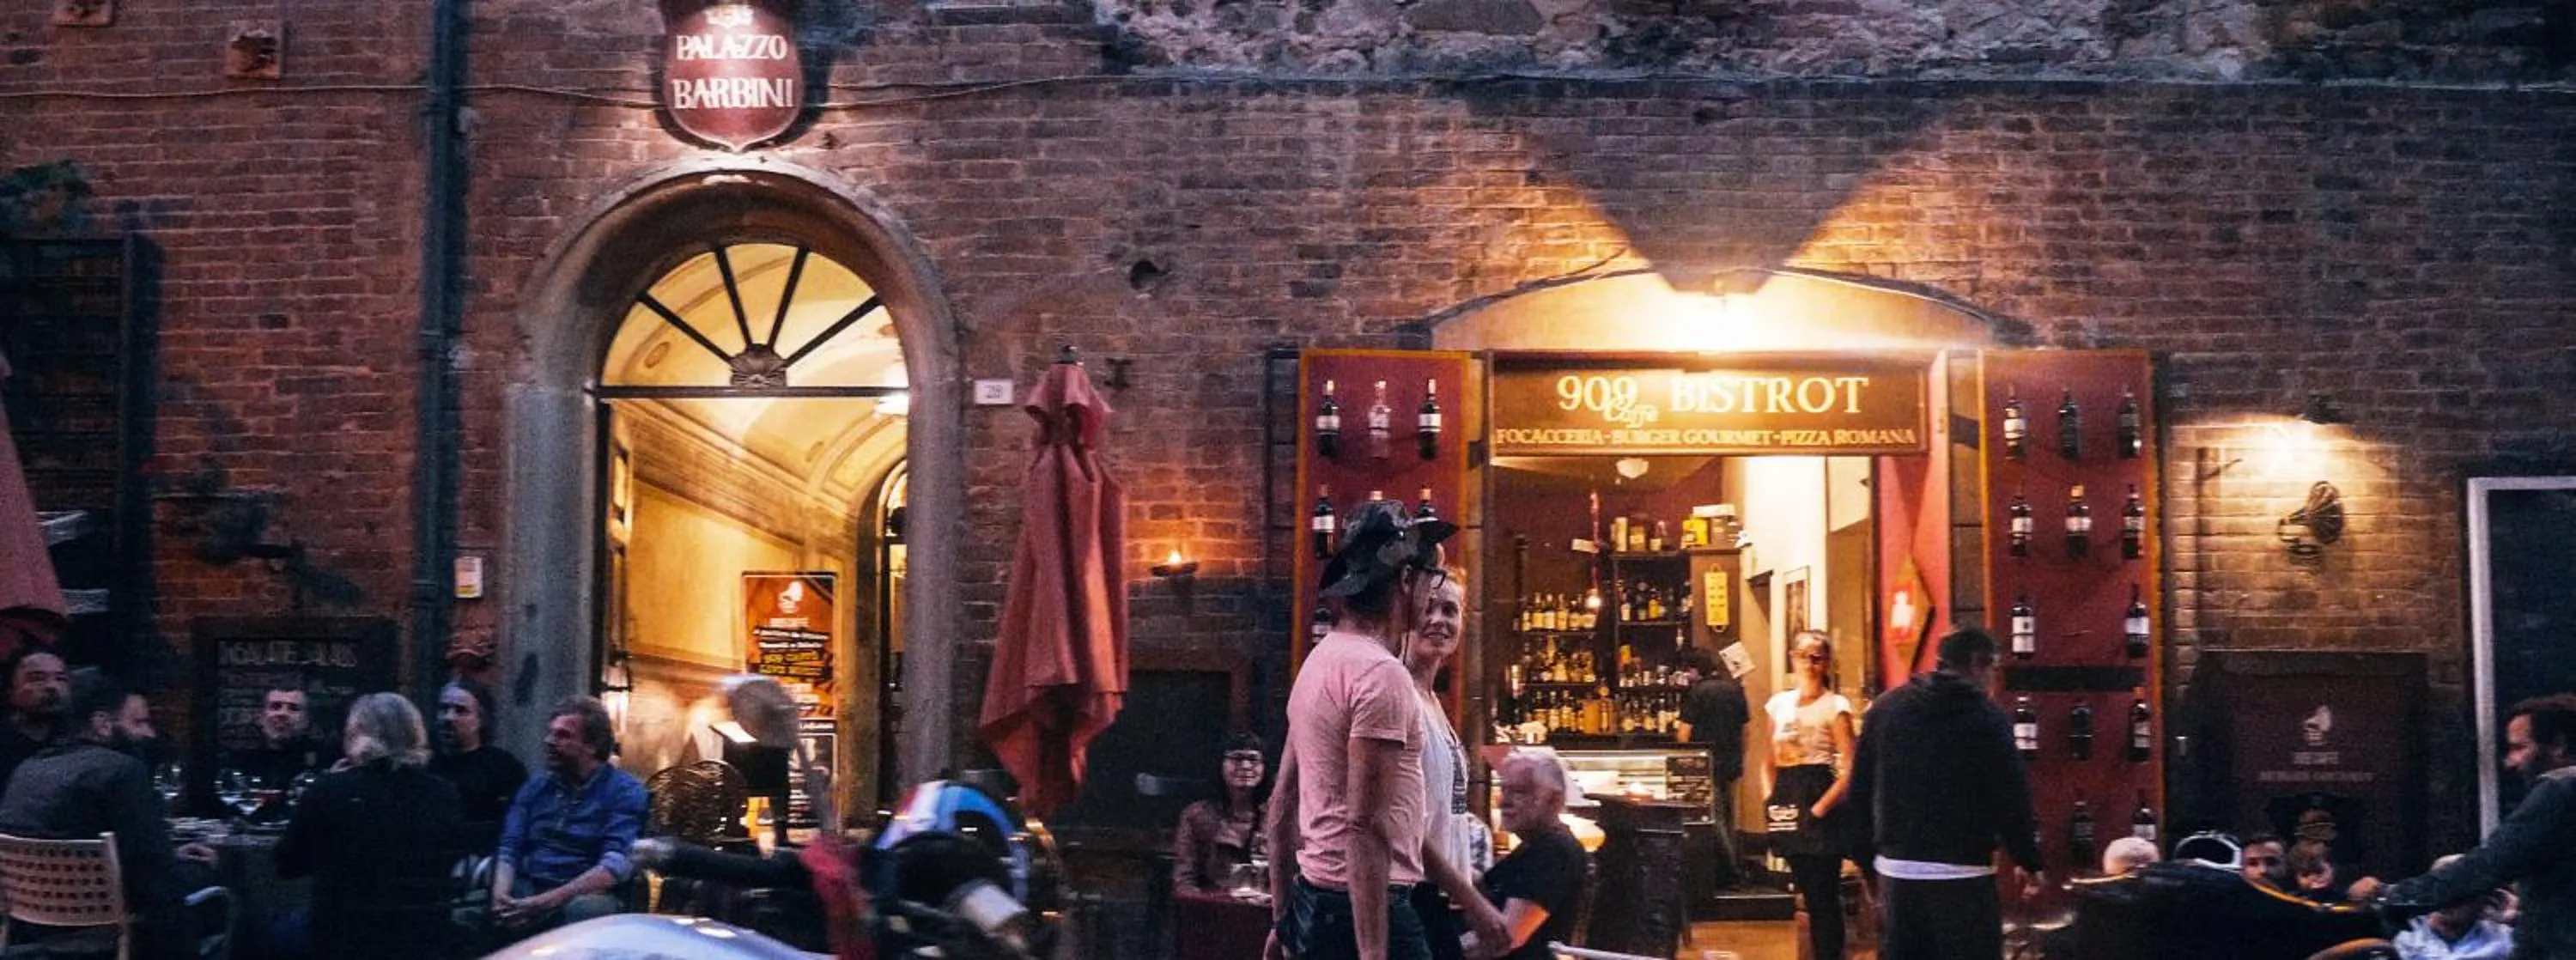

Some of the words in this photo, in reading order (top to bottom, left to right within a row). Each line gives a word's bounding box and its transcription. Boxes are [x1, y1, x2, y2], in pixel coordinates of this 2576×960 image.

[676, 34, 788, 60] PALAZZO
[671, 78, 794, 109] BARBINI
[1557, 375, 1637, 411] 909
[1669, 375, 1869, 413] BISTROT
[1781, 430, 1832, 446] PIZZA
[1833, 429, 1917, 445] ROMANA
